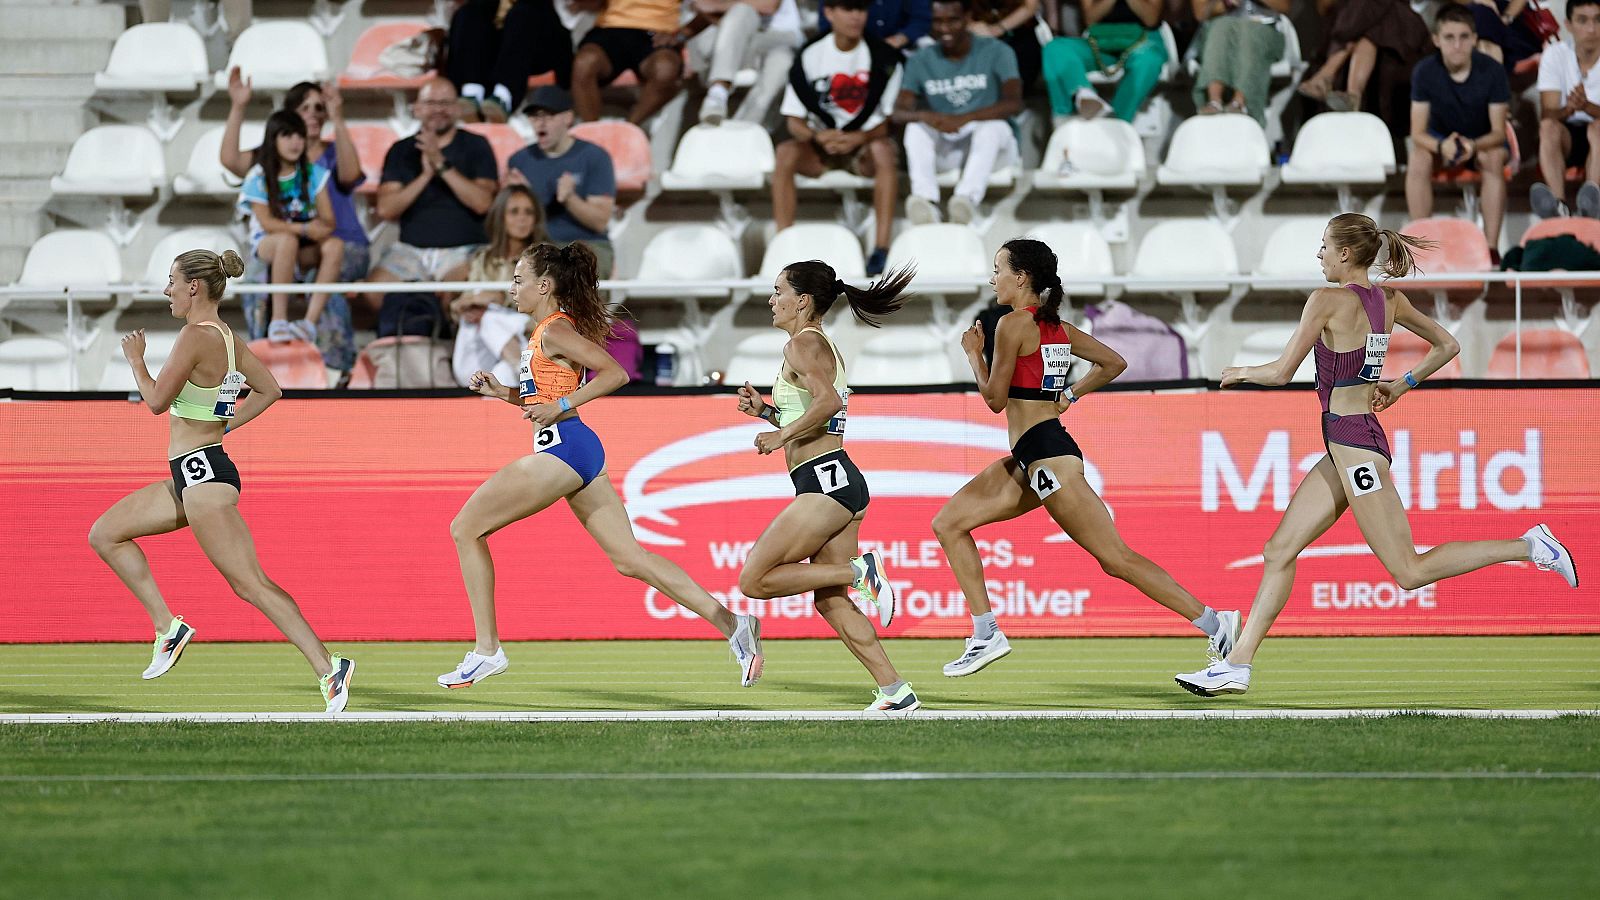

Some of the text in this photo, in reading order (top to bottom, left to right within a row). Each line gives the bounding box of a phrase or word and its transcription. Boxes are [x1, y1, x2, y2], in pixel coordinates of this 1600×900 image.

[537, 429, 554, 447] 5
[186, 456, 207, 481] 9
[820, 463, 838, 487] 7
[1038, 469, 1054, 491] 4
[1201, 429, 1544, 512] Mrid
[1354, 466, 1375, 490] 6
[858, 540, 1014, 568] THLECS
[985, 579, 1091, 618] Silver
[1312, 582, 1437, 610] EUROPE
